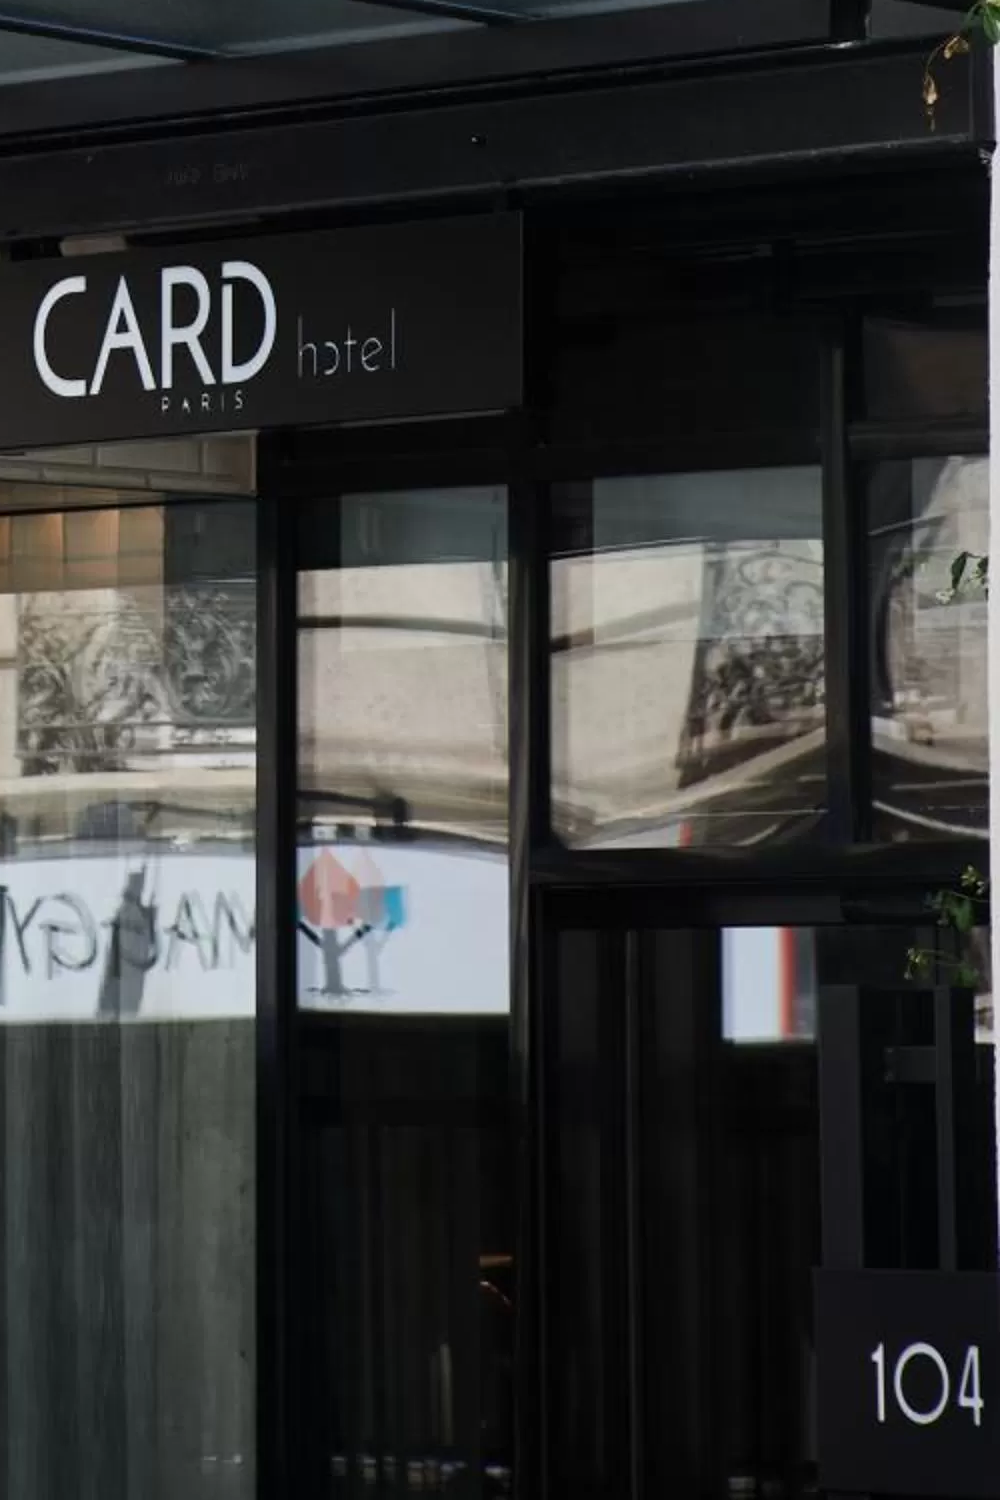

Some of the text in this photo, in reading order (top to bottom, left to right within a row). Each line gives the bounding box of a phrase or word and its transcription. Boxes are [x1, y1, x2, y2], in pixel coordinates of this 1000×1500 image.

[33, 260, 277, 398] CARD
[160, 389, 245, 415] PARIS
[870, 1341, 985, 1427] 104
